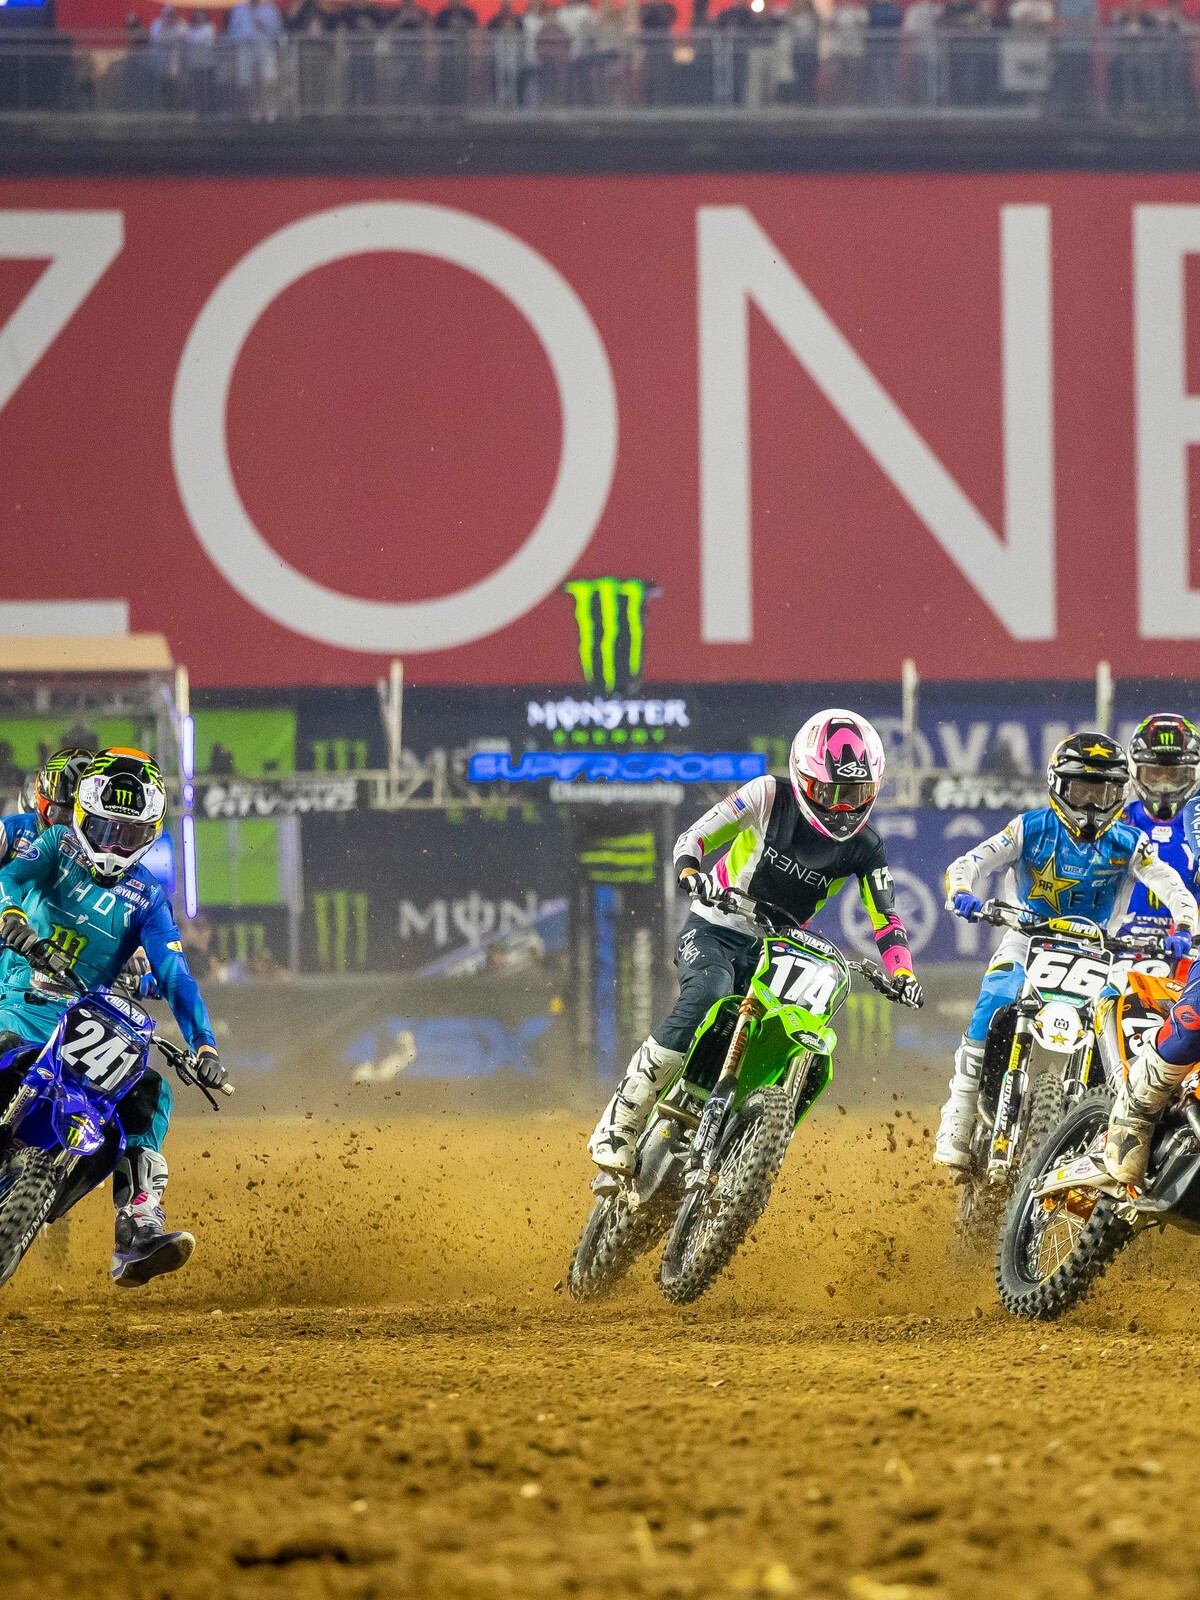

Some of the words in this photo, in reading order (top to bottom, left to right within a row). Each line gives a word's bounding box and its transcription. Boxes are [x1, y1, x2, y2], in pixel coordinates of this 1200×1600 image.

[121, 888, 150, 910] YAMAHA
[769, 954, 837, 1017] 174
[1027, 951, 1109, 999] 66
[61, 1019, 140, 1092] 241
[20, 1188, 57, 1252] DUNLOP
